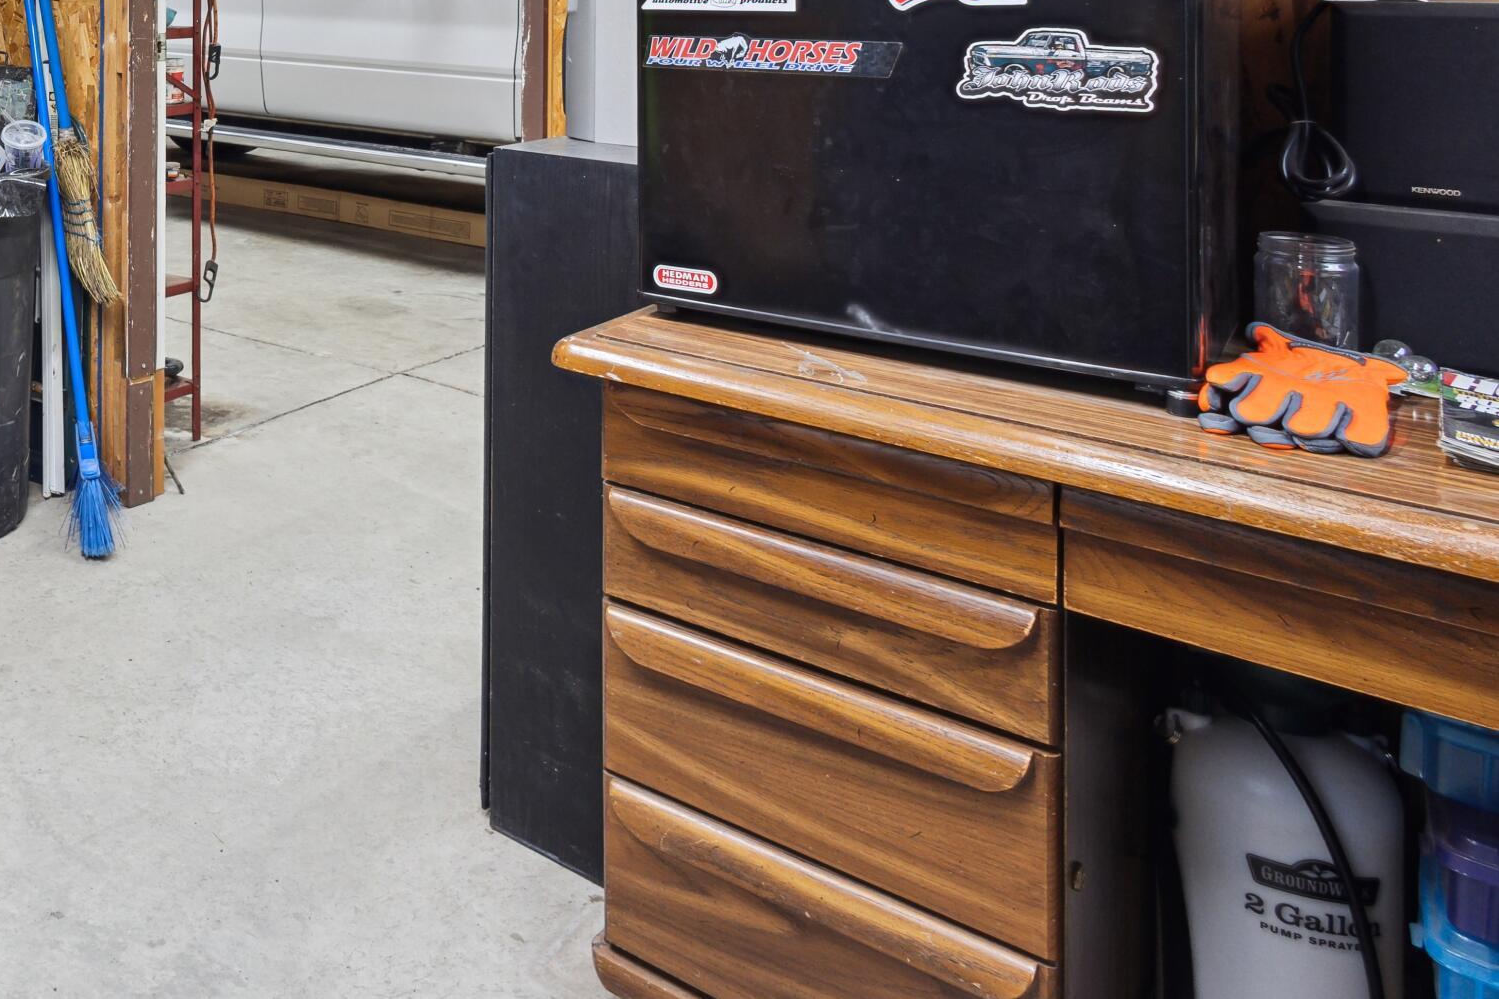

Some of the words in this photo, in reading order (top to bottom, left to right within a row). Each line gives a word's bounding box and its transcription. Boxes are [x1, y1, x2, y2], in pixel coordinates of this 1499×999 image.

[649, 36, 717, 60] WILD
[744, 39, 863, 66] HORSES
[646, 57, 701, 66] FOUR
[783, 63, 855, 73] DRIVE
[1028, 91, 1075, 104] Drop
[1079, 93, 1146, 106] Beams
[1411, 186, 1461, 197] KENWOOD
[662, 270, 708, 282] HEDMAN
[662, 277, 708, 288] HEDDERS
[1245, 893, 1264, 916] 2
[1260, 921, 1303, 942] PUMP
